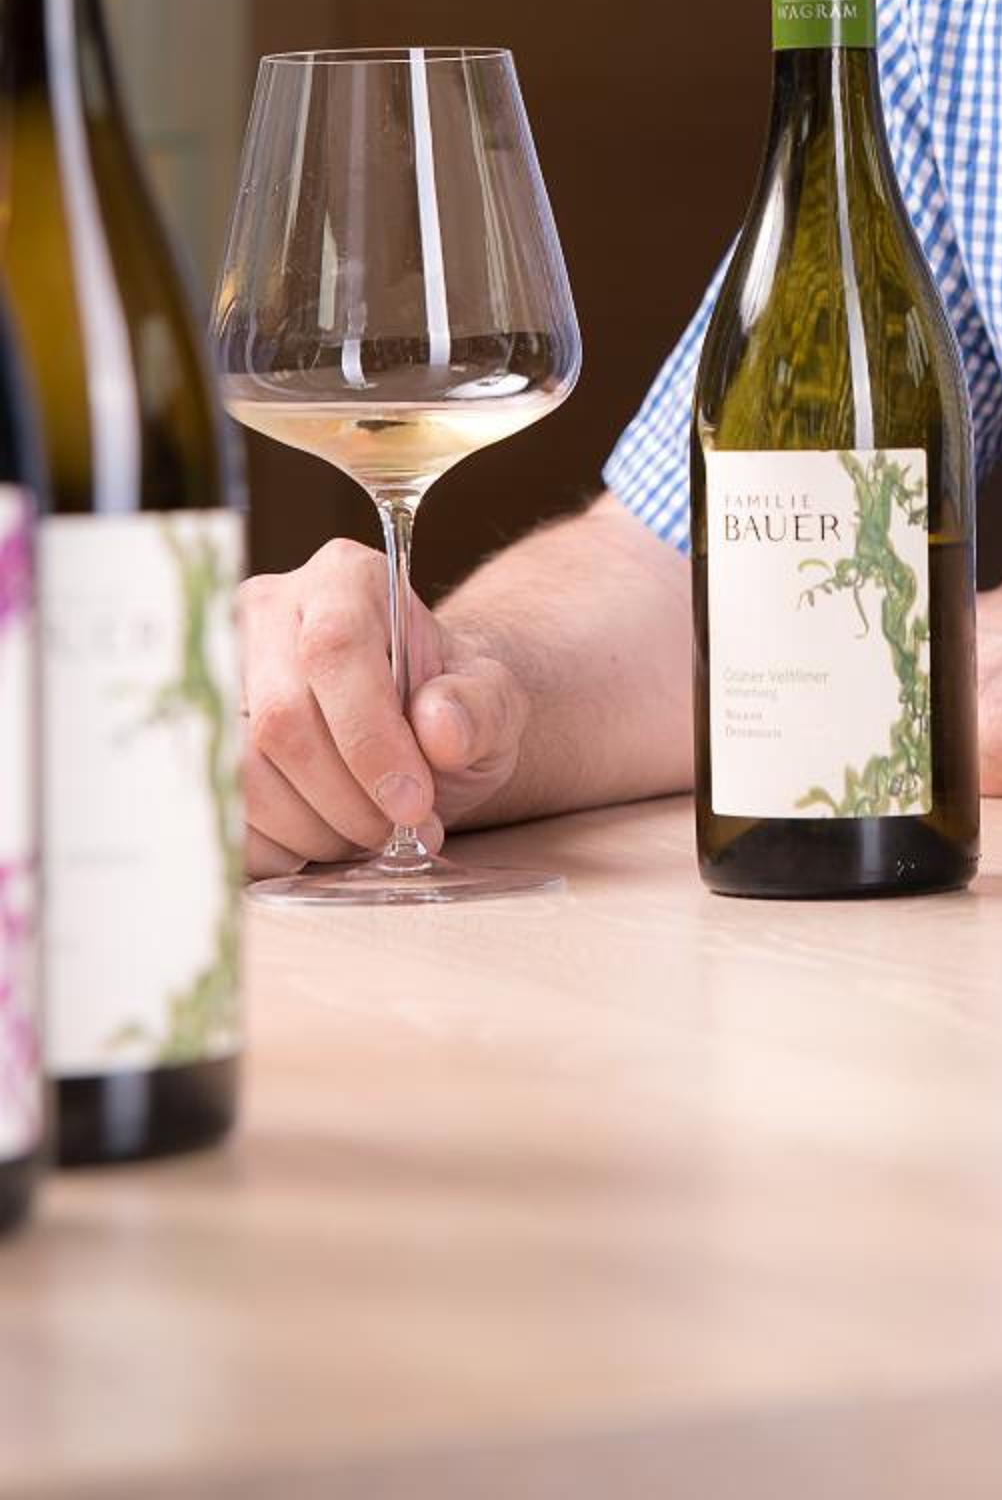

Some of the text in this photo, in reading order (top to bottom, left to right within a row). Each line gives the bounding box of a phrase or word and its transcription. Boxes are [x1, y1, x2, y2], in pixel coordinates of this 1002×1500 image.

[777, 3, 857, 20] WAGRAM
[724, 494, 814, 510] FAMILIE
[724, 513, 842, 542] BAUER
